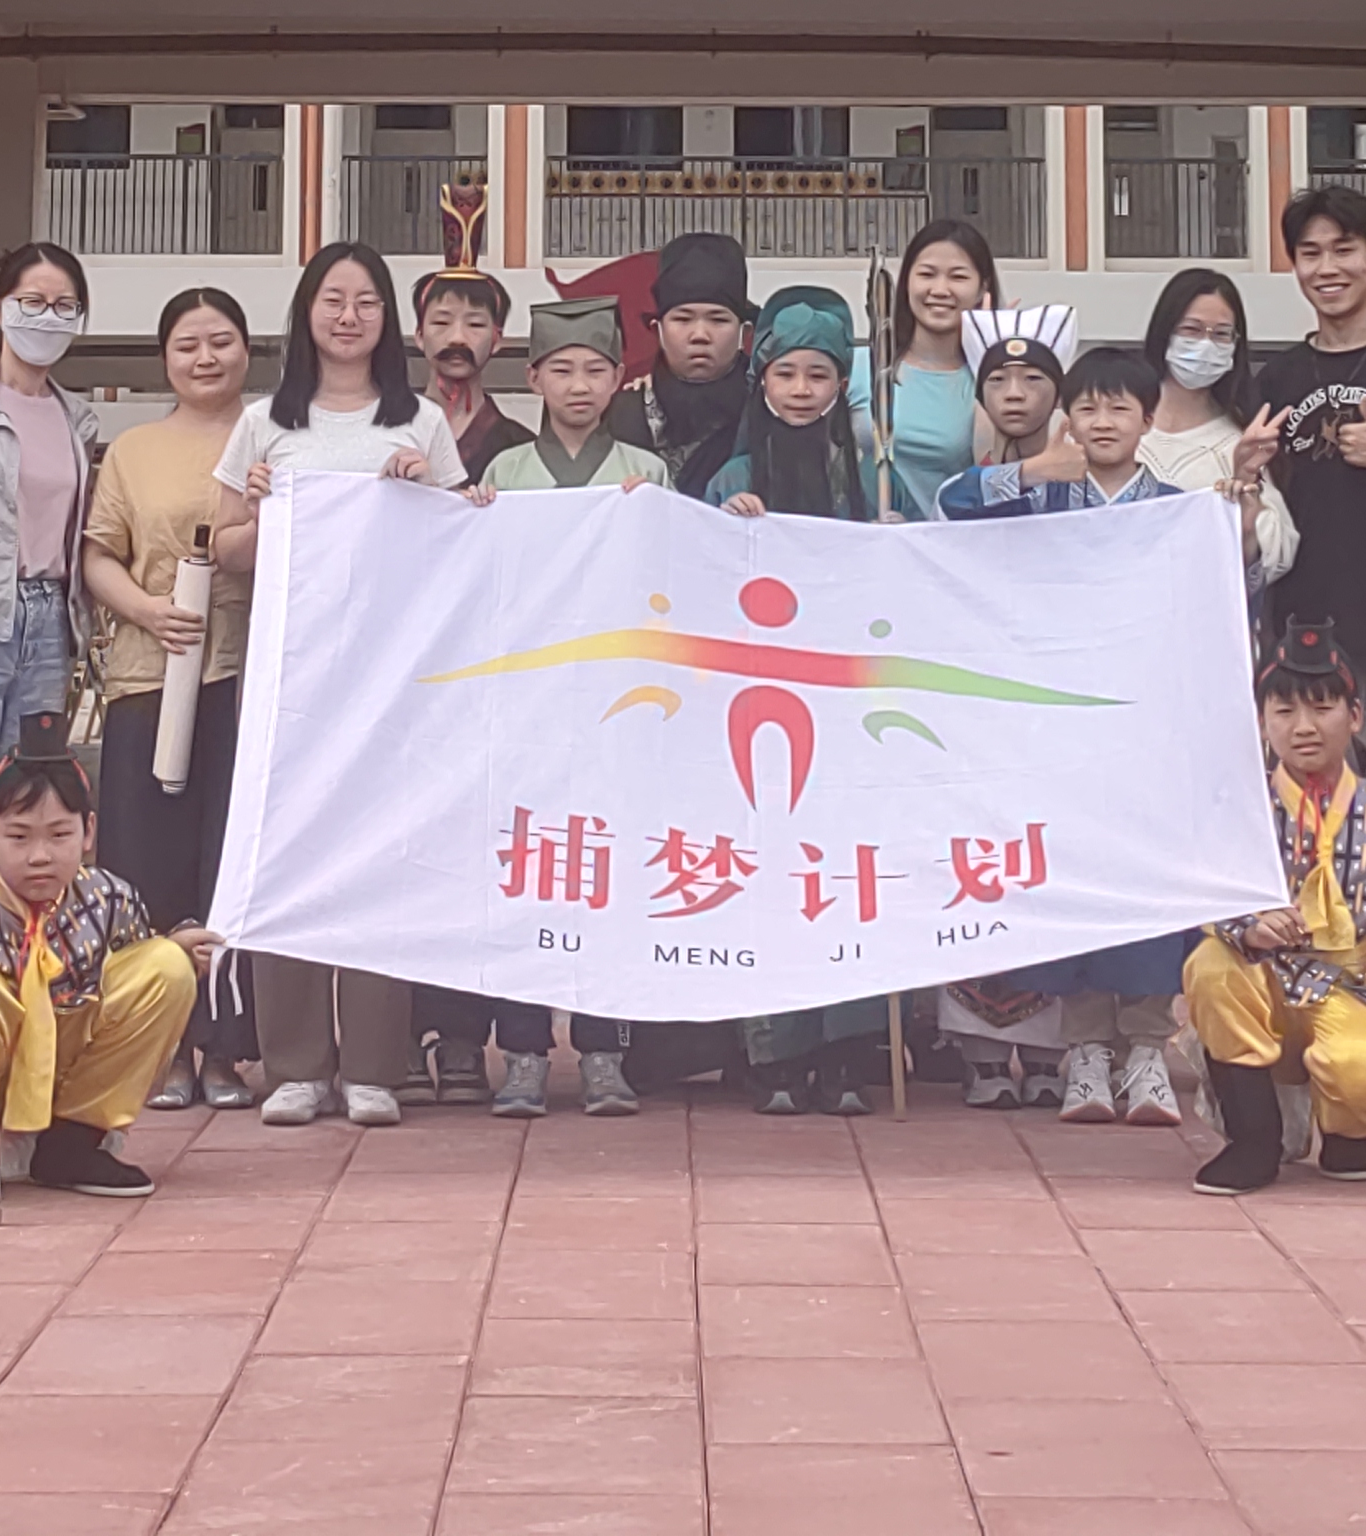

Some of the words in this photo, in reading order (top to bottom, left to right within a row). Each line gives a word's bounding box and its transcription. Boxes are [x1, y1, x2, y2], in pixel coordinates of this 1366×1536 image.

[497, 805, 1047, 924] 捕梦计划
[538, 928, 581, 953] BU
[654, 944, 755, 967] MENG
[830, 944, 861, 962] JI
[937, 921, 1008, 946] HUA
